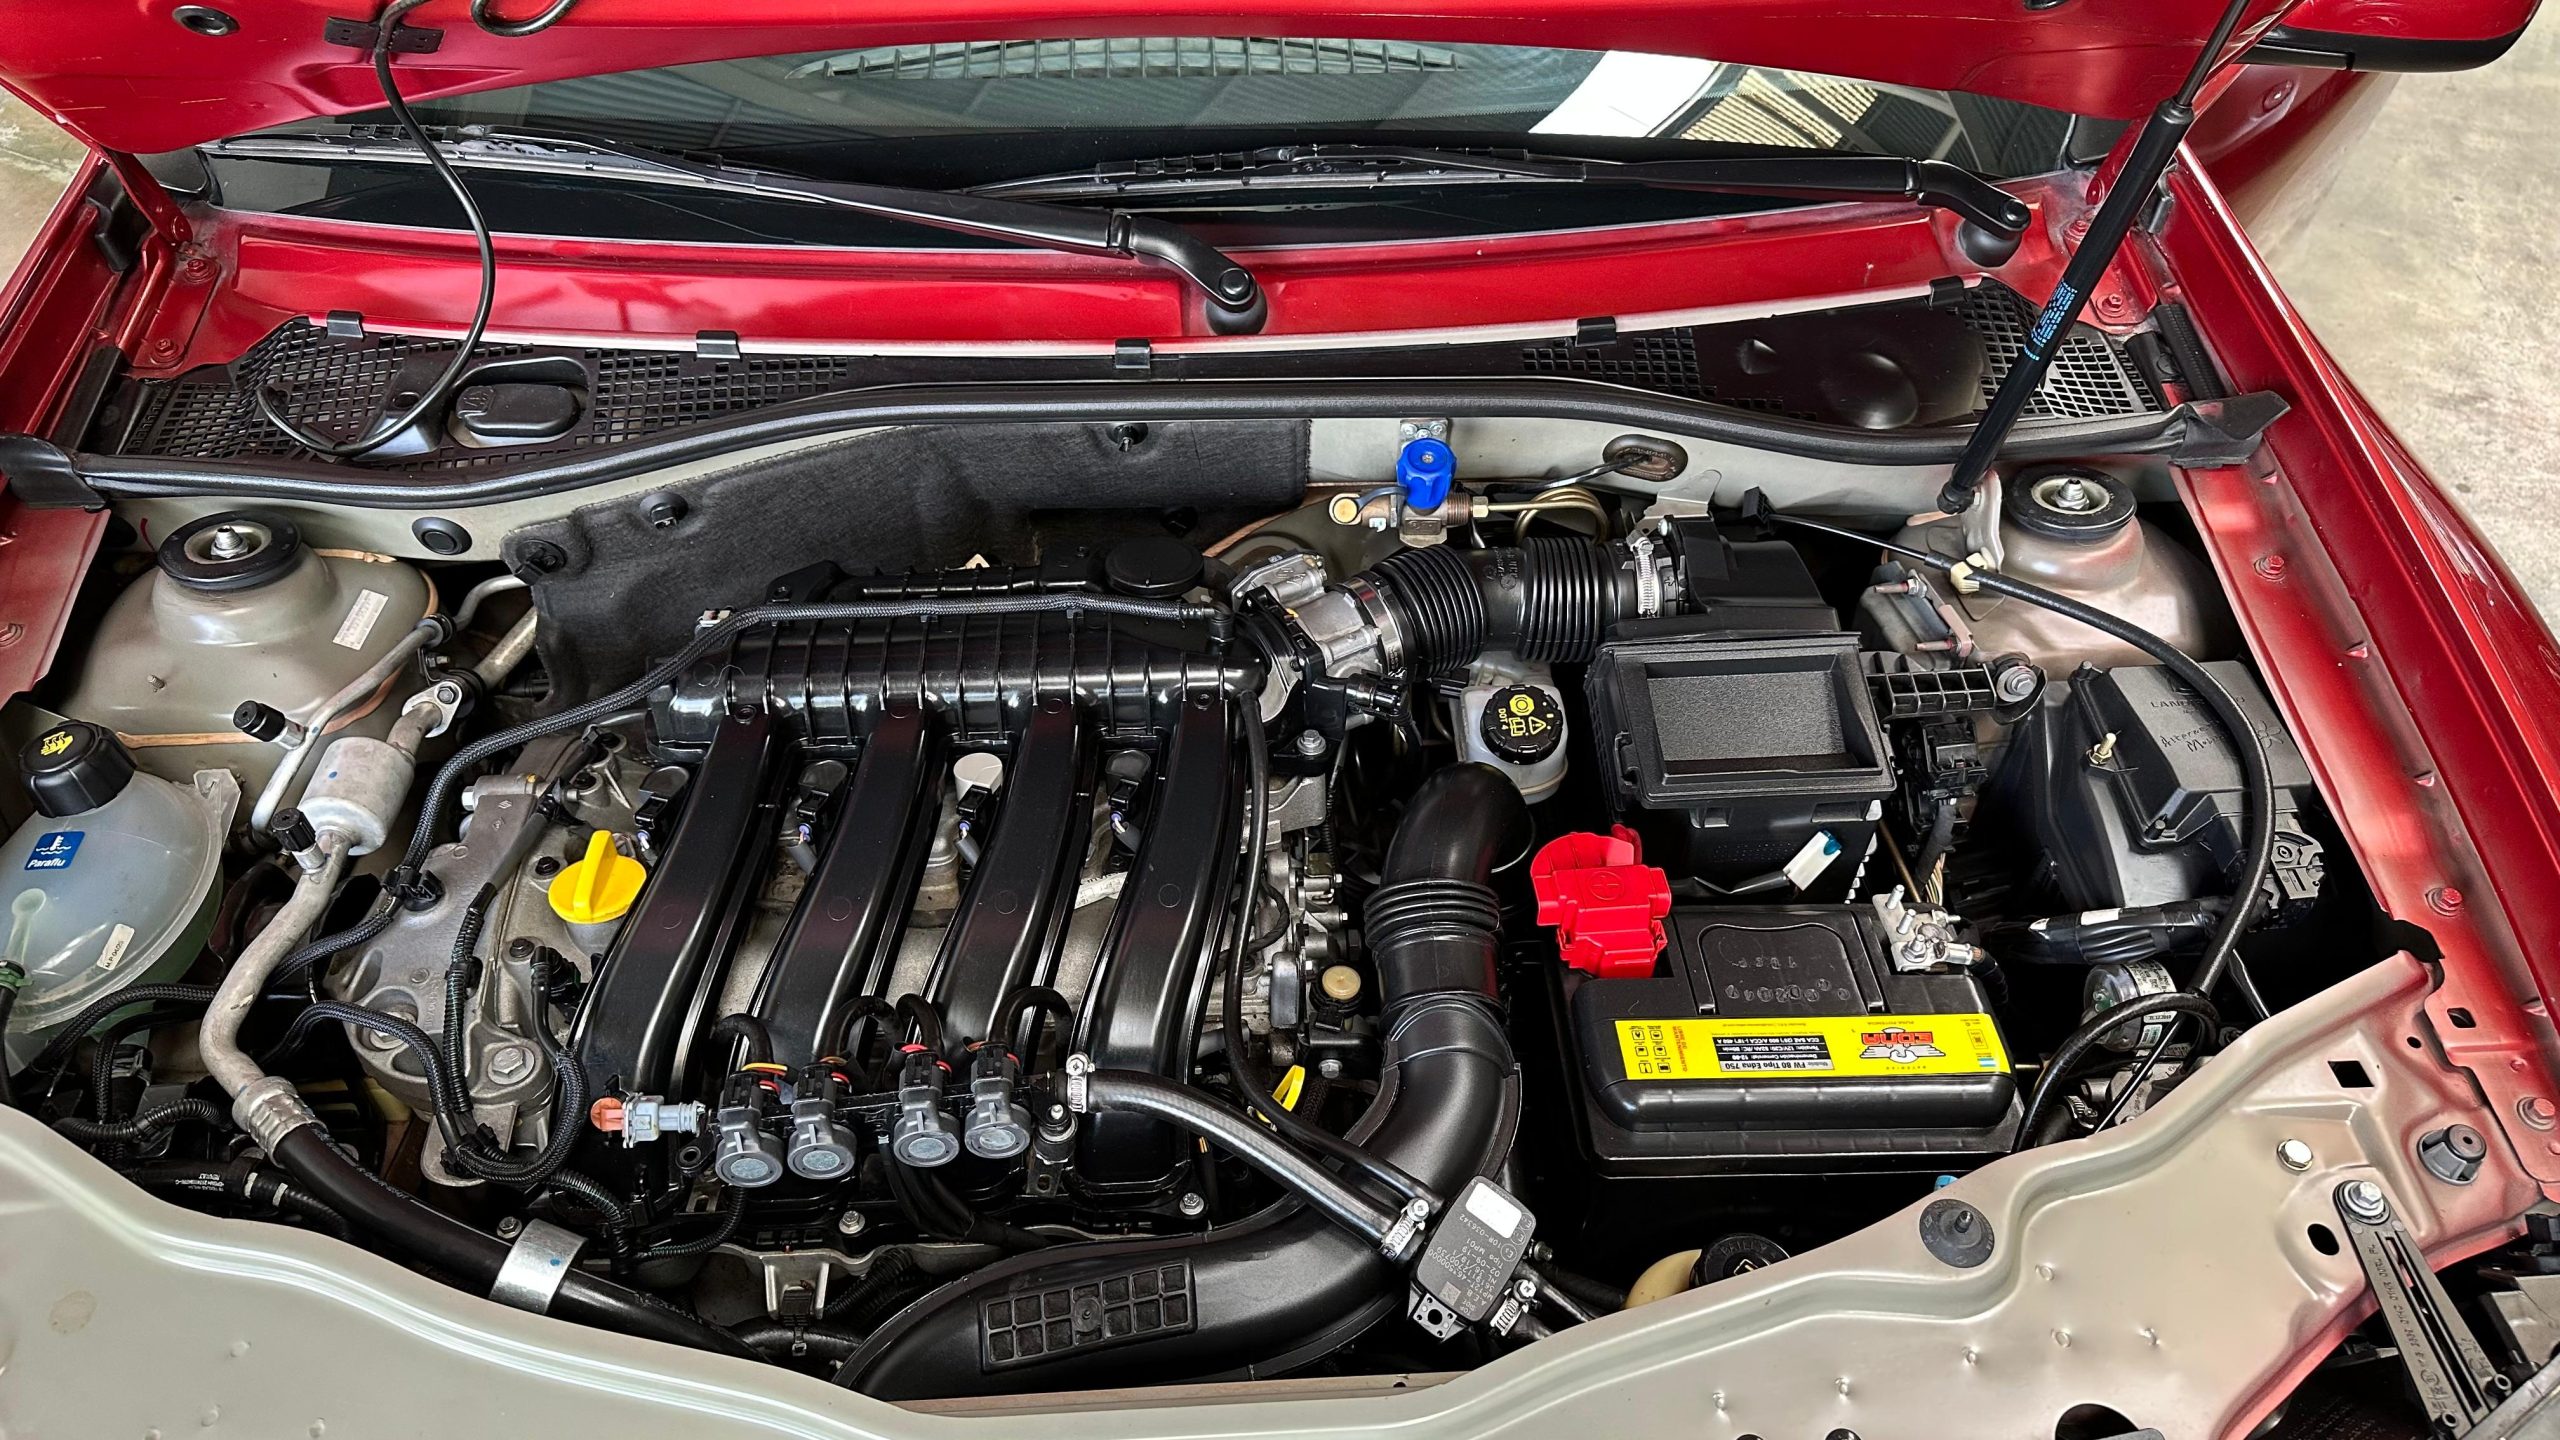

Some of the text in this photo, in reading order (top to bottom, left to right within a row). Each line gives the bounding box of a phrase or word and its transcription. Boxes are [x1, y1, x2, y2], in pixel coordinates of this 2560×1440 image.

[1498, 708, 1508, 723] DOT
[27, 857, 66, 868] Paraflu
[1861, 1031, 1933, 1045] EDNA
[1724, 1061, 1739, 1069] 750
[1741, 1061, 1761, 1069] Edna
[1762, 1060, 1779, 1068] Tipo
[1793, 1060, 1806, 1068] FW
[1486, 1273, 1497, 1285] NL
